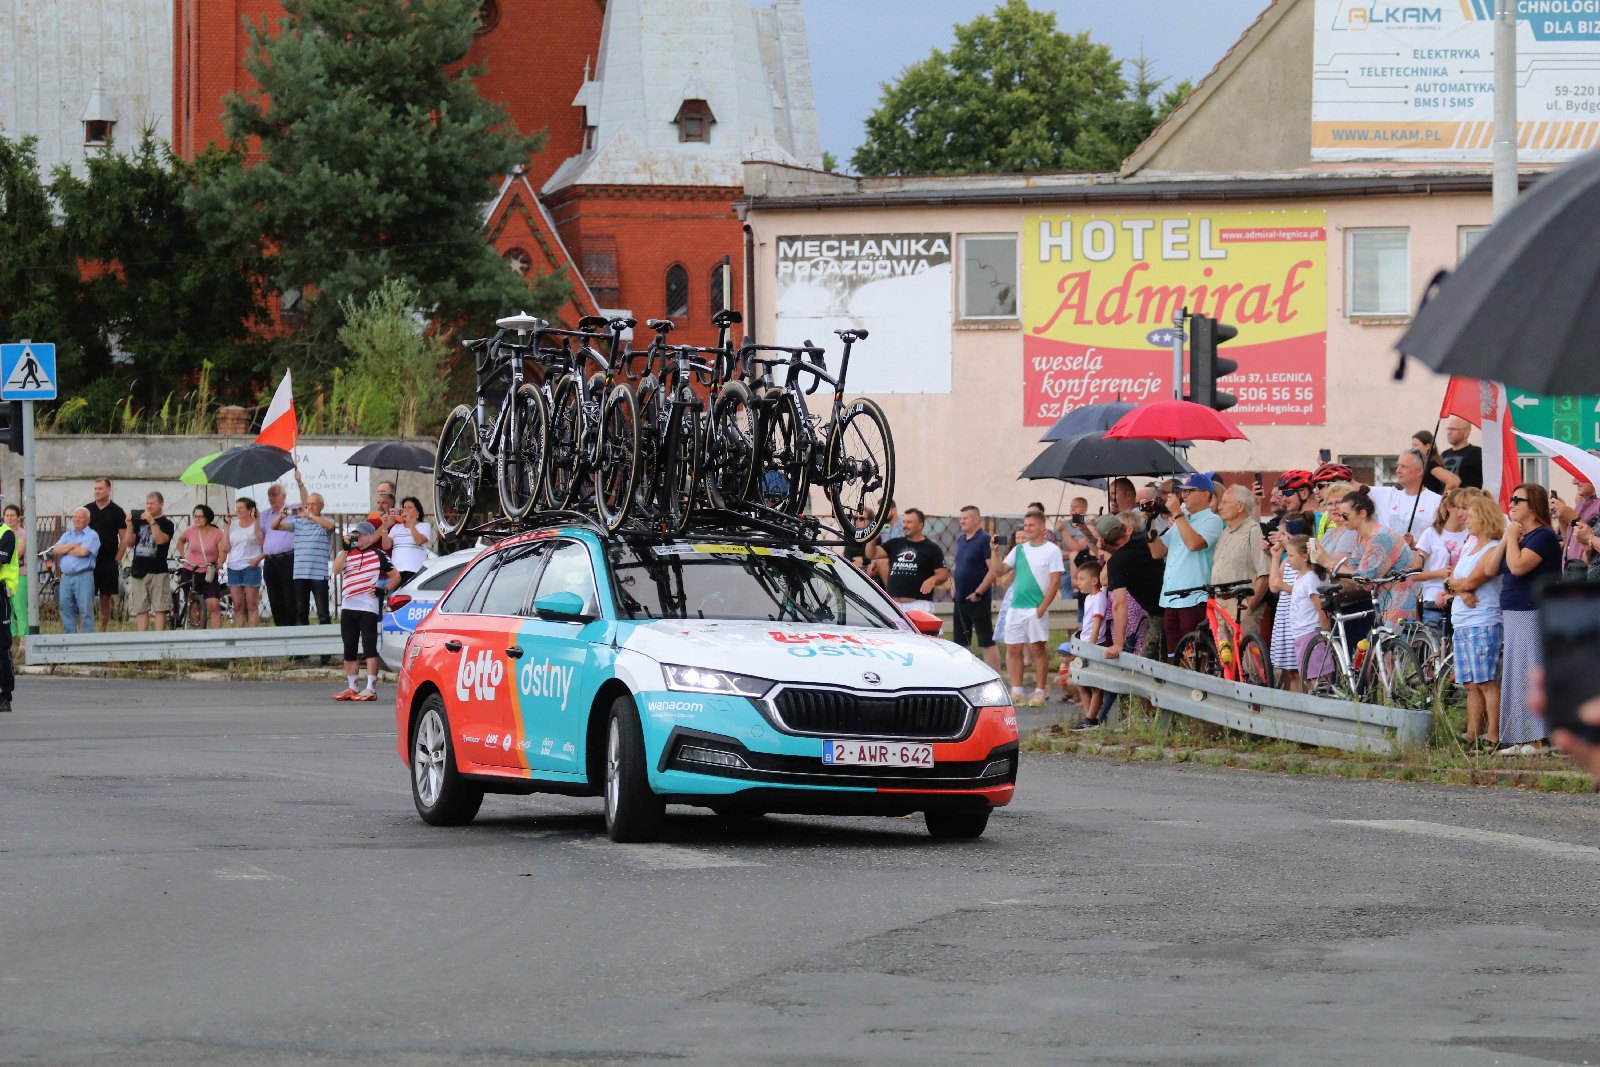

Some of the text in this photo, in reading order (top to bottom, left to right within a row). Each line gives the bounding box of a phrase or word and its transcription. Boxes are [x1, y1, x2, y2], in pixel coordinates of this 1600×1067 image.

[1518, 0, 1600, 13] CHNOLOGI
[1348, 7, 1441, 23] ALKAM
[1544, 21, 1574, 34] DLA
[1413, 49, 1480, 60] ELEKTRYKA
[1360, 67, 1448, 77] TELETECHNIKA
[1415, 83, 1495, 93] AUTOMATYKA
[1555, 86, 1594, 96] 59-220
[1414, 98, 1439, 108] BMS
[1449, 98, 1474, 108] SMS
[1546, 100, 1562, 110] ul.
[1332, 129, 1441, 141] WWW.ALKAM.PL
[1039, 218, 1227, 263] HOTEL
[1222, 230, 1318, 240] www.admiral-legnica.pl
[779, 238, 949, 258] MECHANIKA
[1032, 260, 1313, 335] Admirał
[1032, 348, 1103, 371] wesela
[1041, 371, 1162, 400] konferencje
[1248, 374, 1263, 385] 37,
[1266, 373, 1313, 383] LEGNICA
[1240, 388, 1268, 400] 506
[1272, 388, 1290, 400] 56
[1295, 388, 1313, 400] 56
[1224, 404, 1313, 414] admiral-legnica.pl
[1561, 425, 1572, 441] 3
[786, 643, 914, 667] dstny
[456, 645, 504, 702] lotto
[520, 656, 575, 712] dstny
[648, 701, 704, 712] wanacom
[825, 744, 931, 764] B 2-AWR-642
